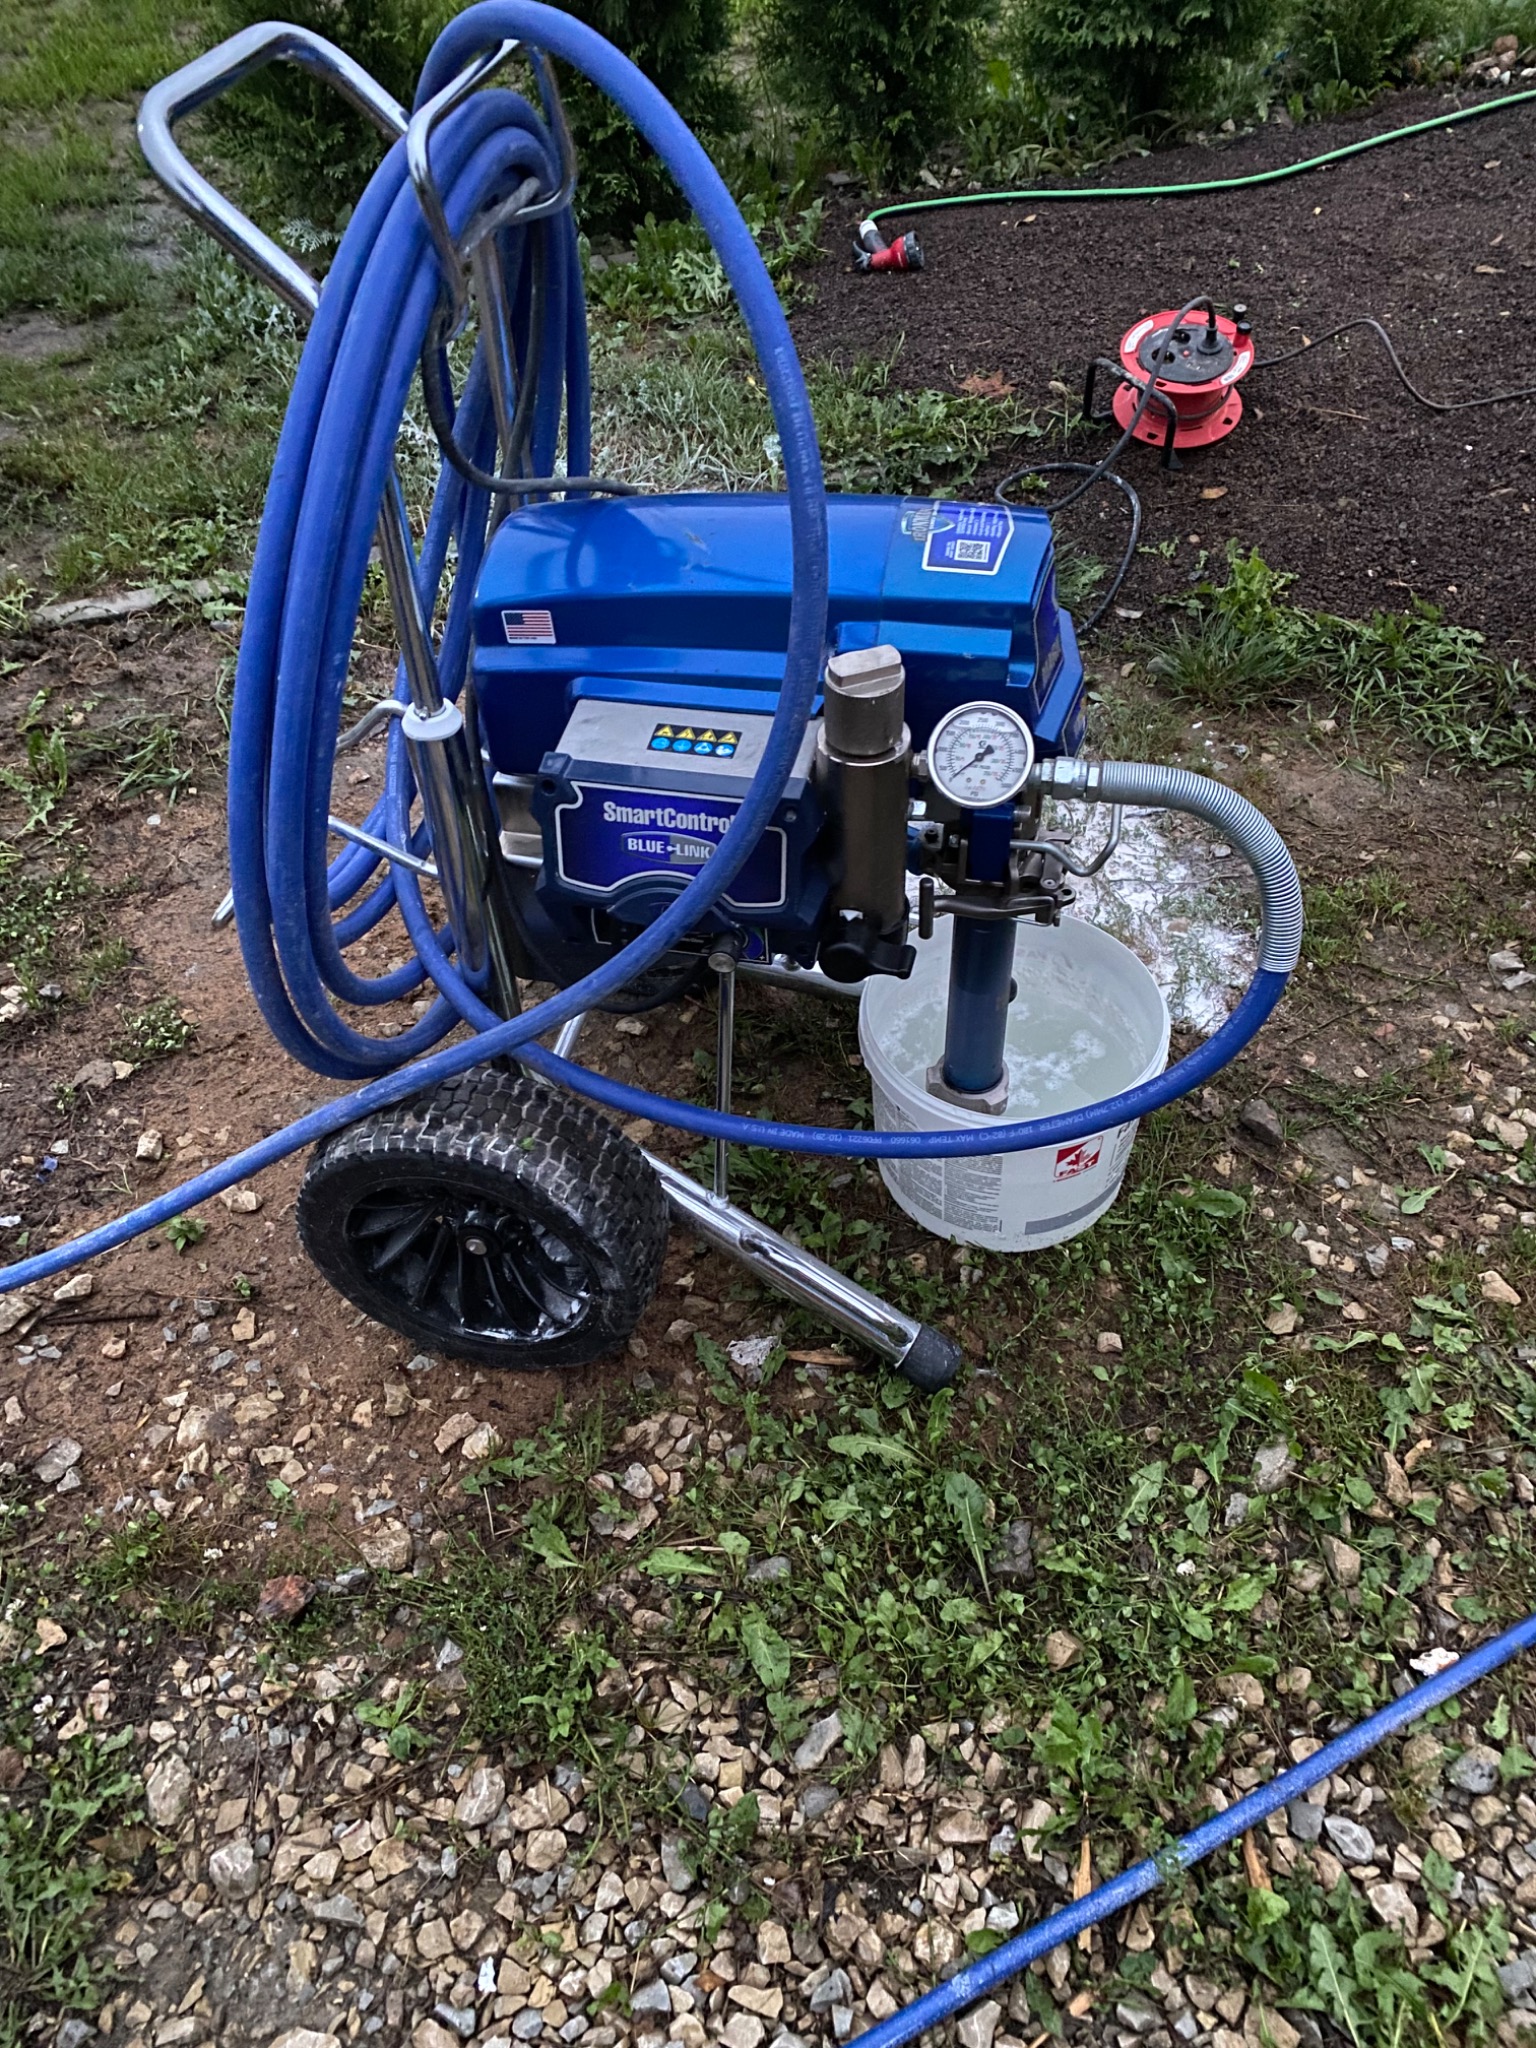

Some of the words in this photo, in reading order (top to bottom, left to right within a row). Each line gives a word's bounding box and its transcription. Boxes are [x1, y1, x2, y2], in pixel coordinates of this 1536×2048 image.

[627, 838, 665, 854] BLUE
[676, 843, 711, 859] LINK
[1038, 1110, 1084, 1132] DIAMETER
[767, 1128, 778, 1136] IN
[780, 1128, 805, 1139] MADE
[928, 1135, 954, 1144] TEMP
[956, 1133, 975, 1143] MAX
[1059, 1158, 1097, 1178] FAST
